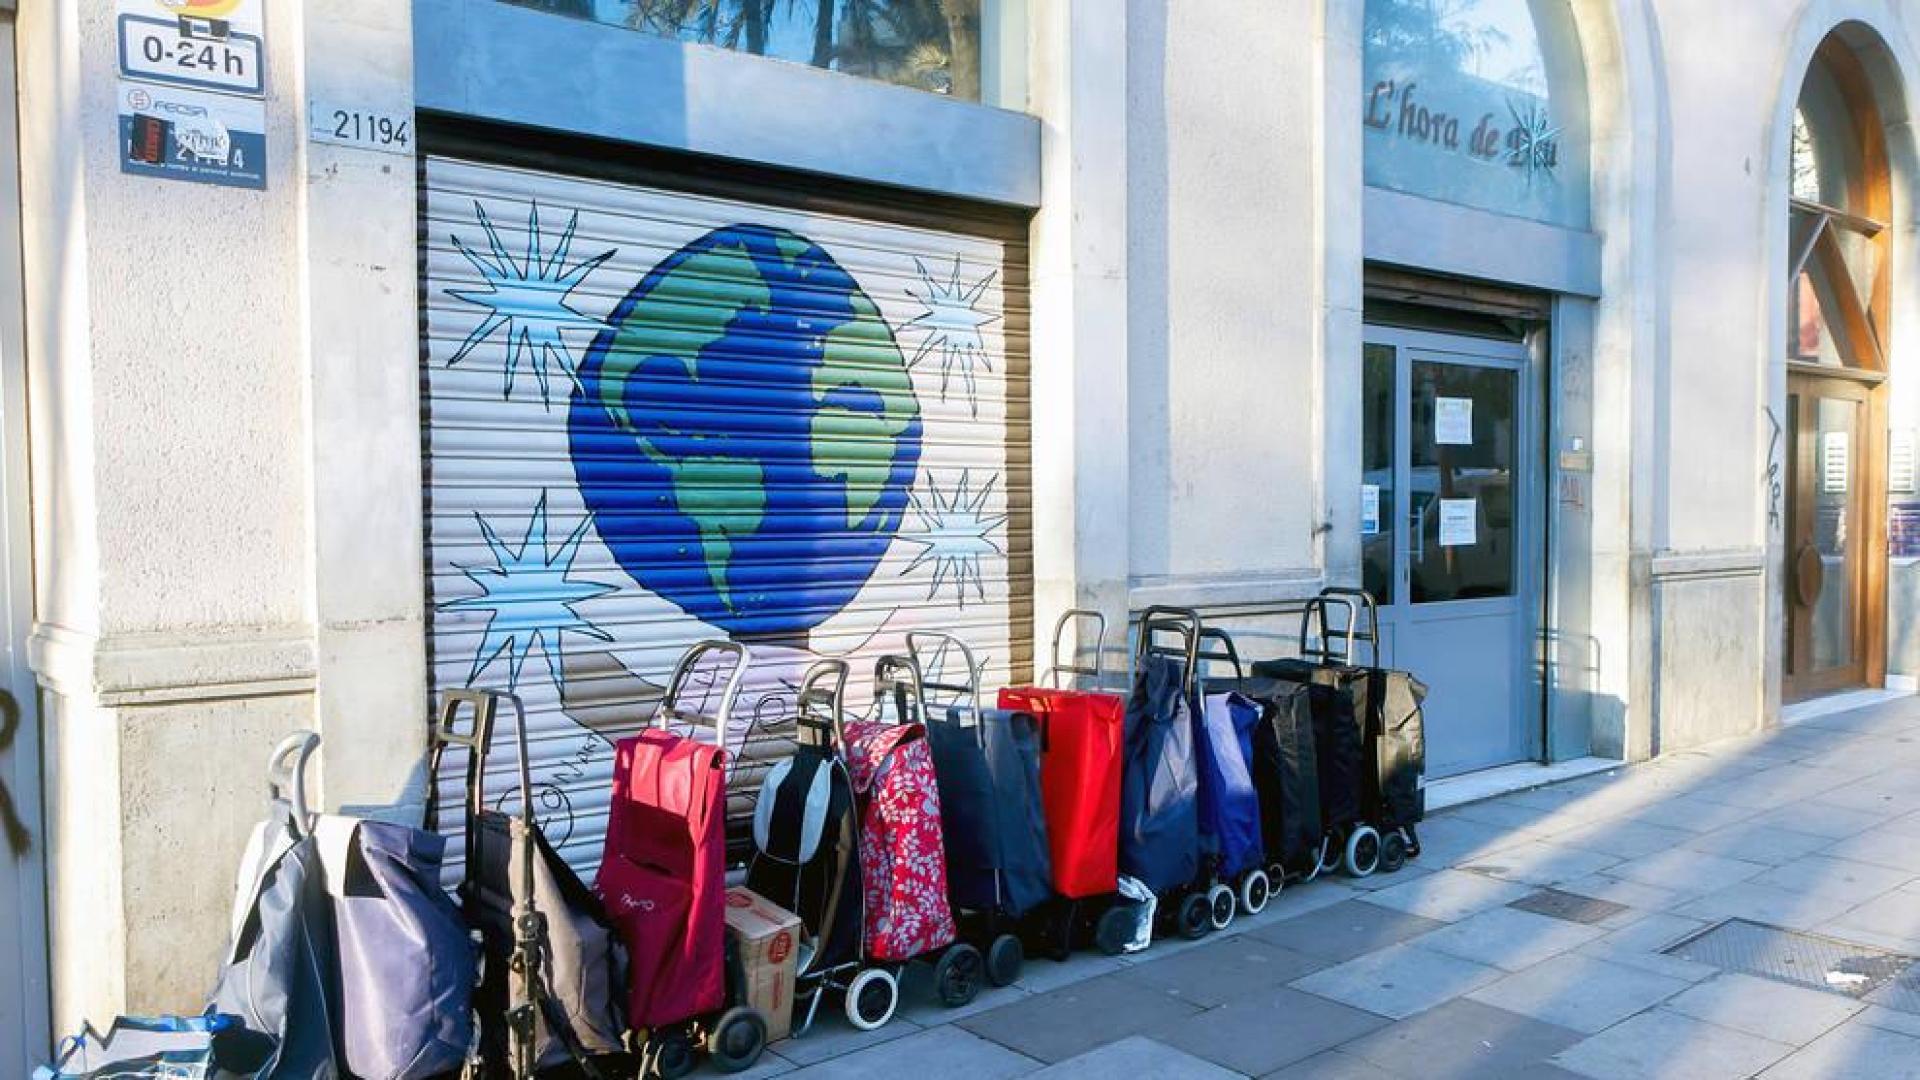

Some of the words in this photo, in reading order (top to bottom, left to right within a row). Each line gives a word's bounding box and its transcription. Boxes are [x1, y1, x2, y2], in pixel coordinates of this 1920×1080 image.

[143, 36, 216, 71] 0-24
[225, 48, 244, 75] h
[333, 110, 408, 147] 21194
[1469, 112, 1499, 158] de
